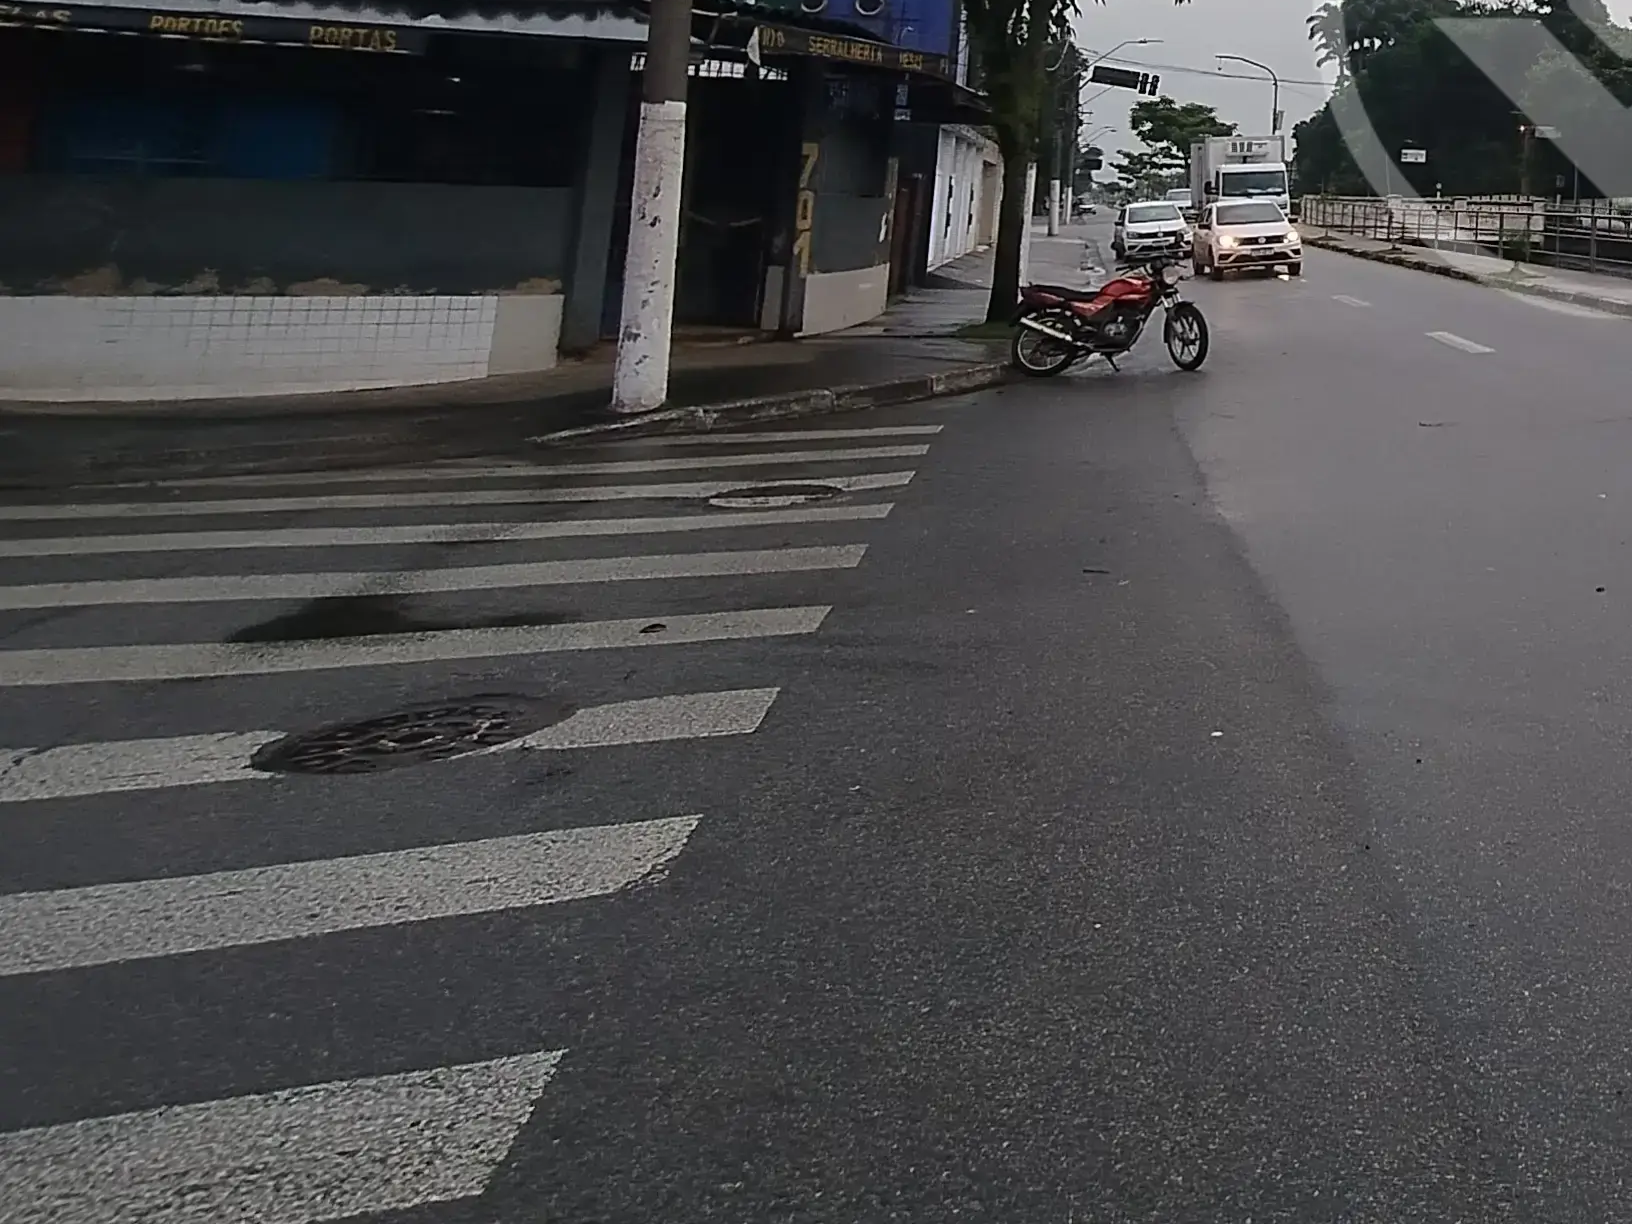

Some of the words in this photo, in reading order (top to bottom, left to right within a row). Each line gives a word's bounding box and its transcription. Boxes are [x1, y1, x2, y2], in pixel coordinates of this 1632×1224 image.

[309, 25, 397, 50] PORTAS
[808, 35, 883, 64] SERRALHERIA
[793, 142, 819, 278] 701
